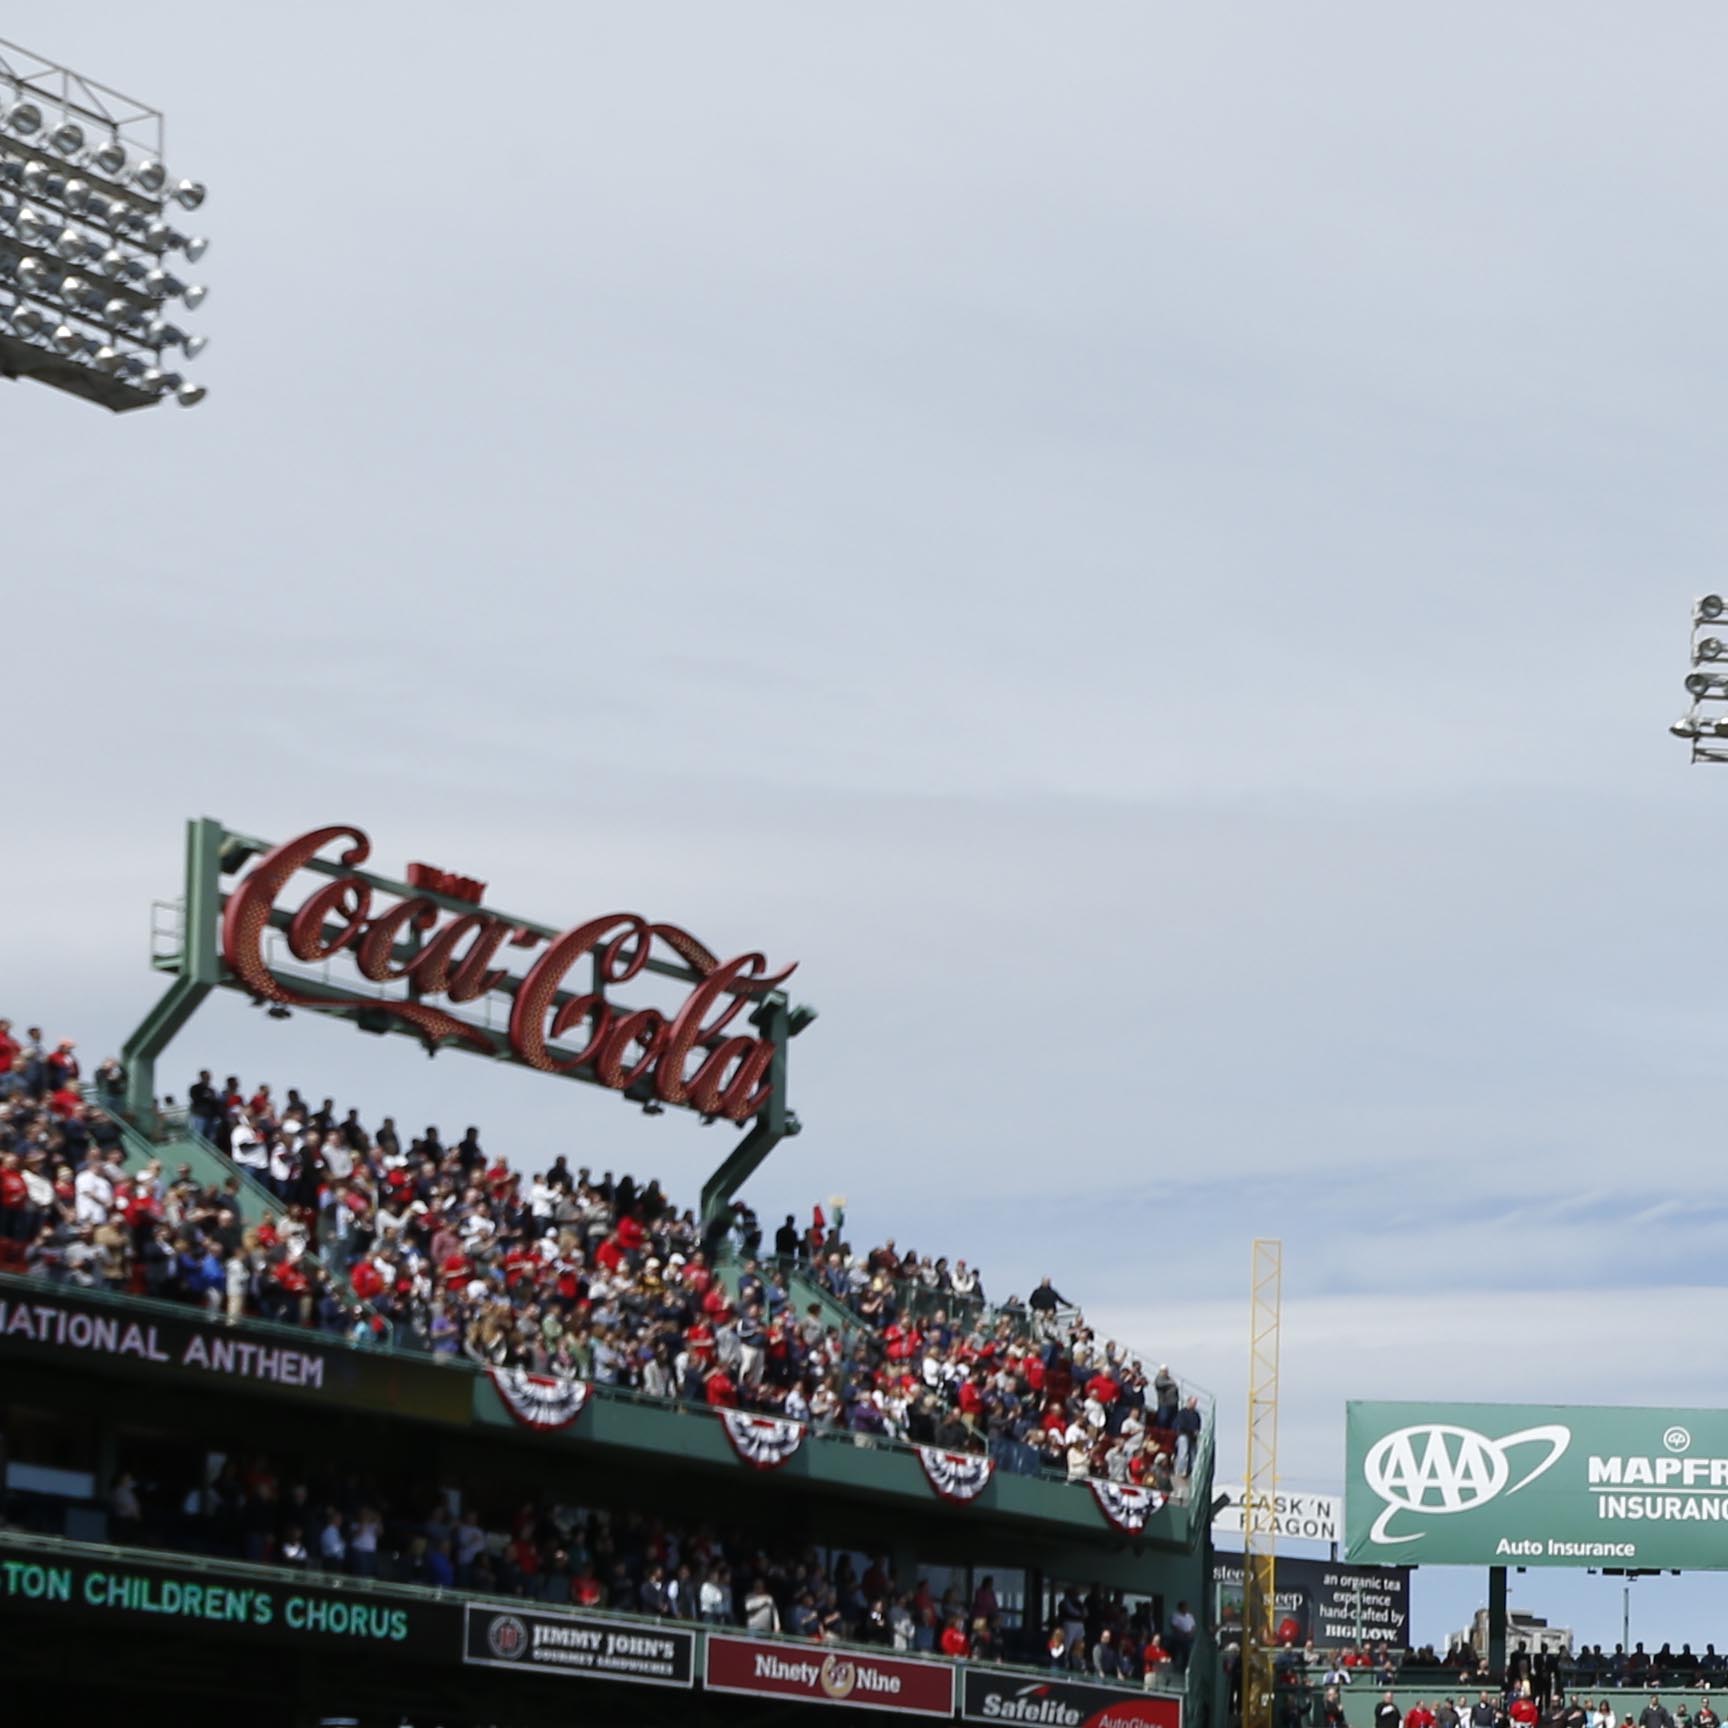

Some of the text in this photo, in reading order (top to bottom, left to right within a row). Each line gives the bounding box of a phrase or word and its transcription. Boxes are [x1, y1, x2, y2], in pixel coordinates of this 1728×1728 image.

[182, 1335, 324, 1389] ANTHEM
[1381, 1427, 1491, 1506] AAA
[1495, 1538, 1636, 1559] Auto Insurance
[1323, 1573, 1338, 1586] an
[1383, 1576, 1402, 1591] tea
[1332, 1590, 1392, 1607] expeience
[1, 1559, 408, 1641] TON CHILDREN'S CHORUS
[1263, 1591, 1303, 1612] seep
[1319, 1604, 1405, 1628] hand-cafted by
[532, 1624, 602, 1650] JIMMY
[605, 1633, 676, 1660] JOHN'S
[754, 1653, 902, 1694] Ninety Nine
[981, 1694, 1080, 1727] Safelite
